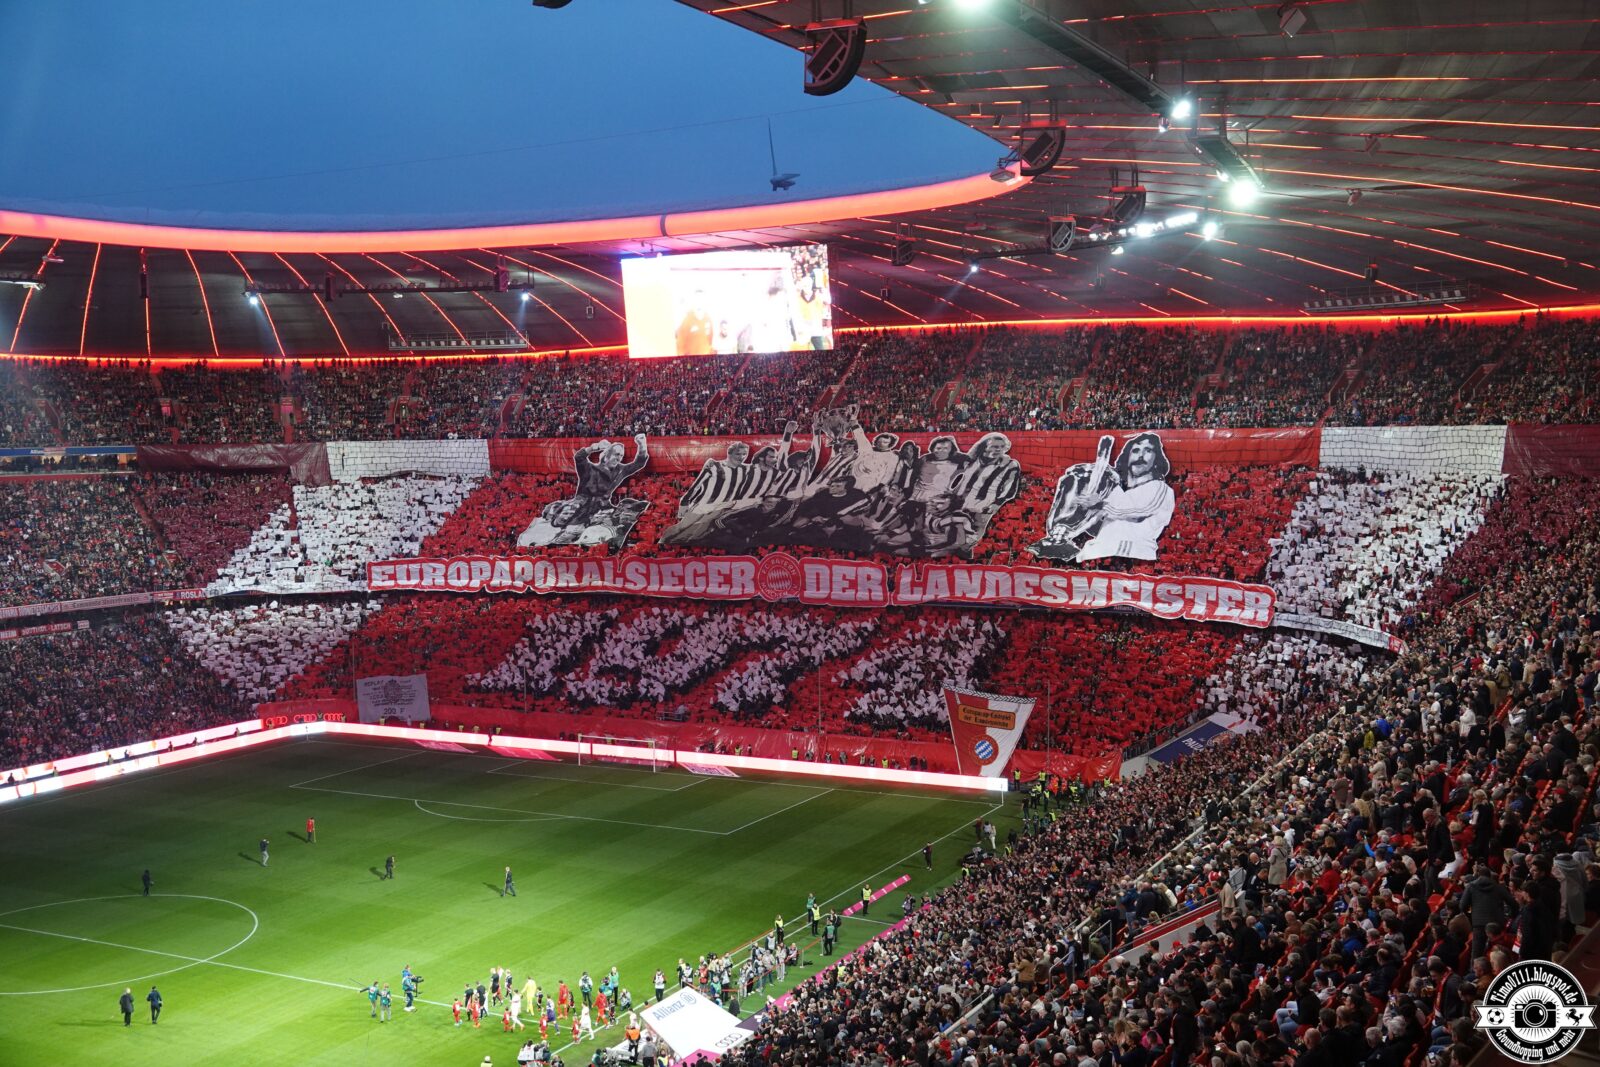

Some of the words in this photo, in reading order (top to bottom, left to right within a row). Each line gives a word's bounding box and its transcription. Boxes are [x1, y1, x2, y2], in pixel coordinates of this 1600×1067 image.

[370, 559, 756, 596] EUROPAPOKALSIEGER
[803, 563, 883, 600] DER
[899, 568, 1272, 621] LANDESMEISTER
[652, 998, 685, 1021] Allianz
